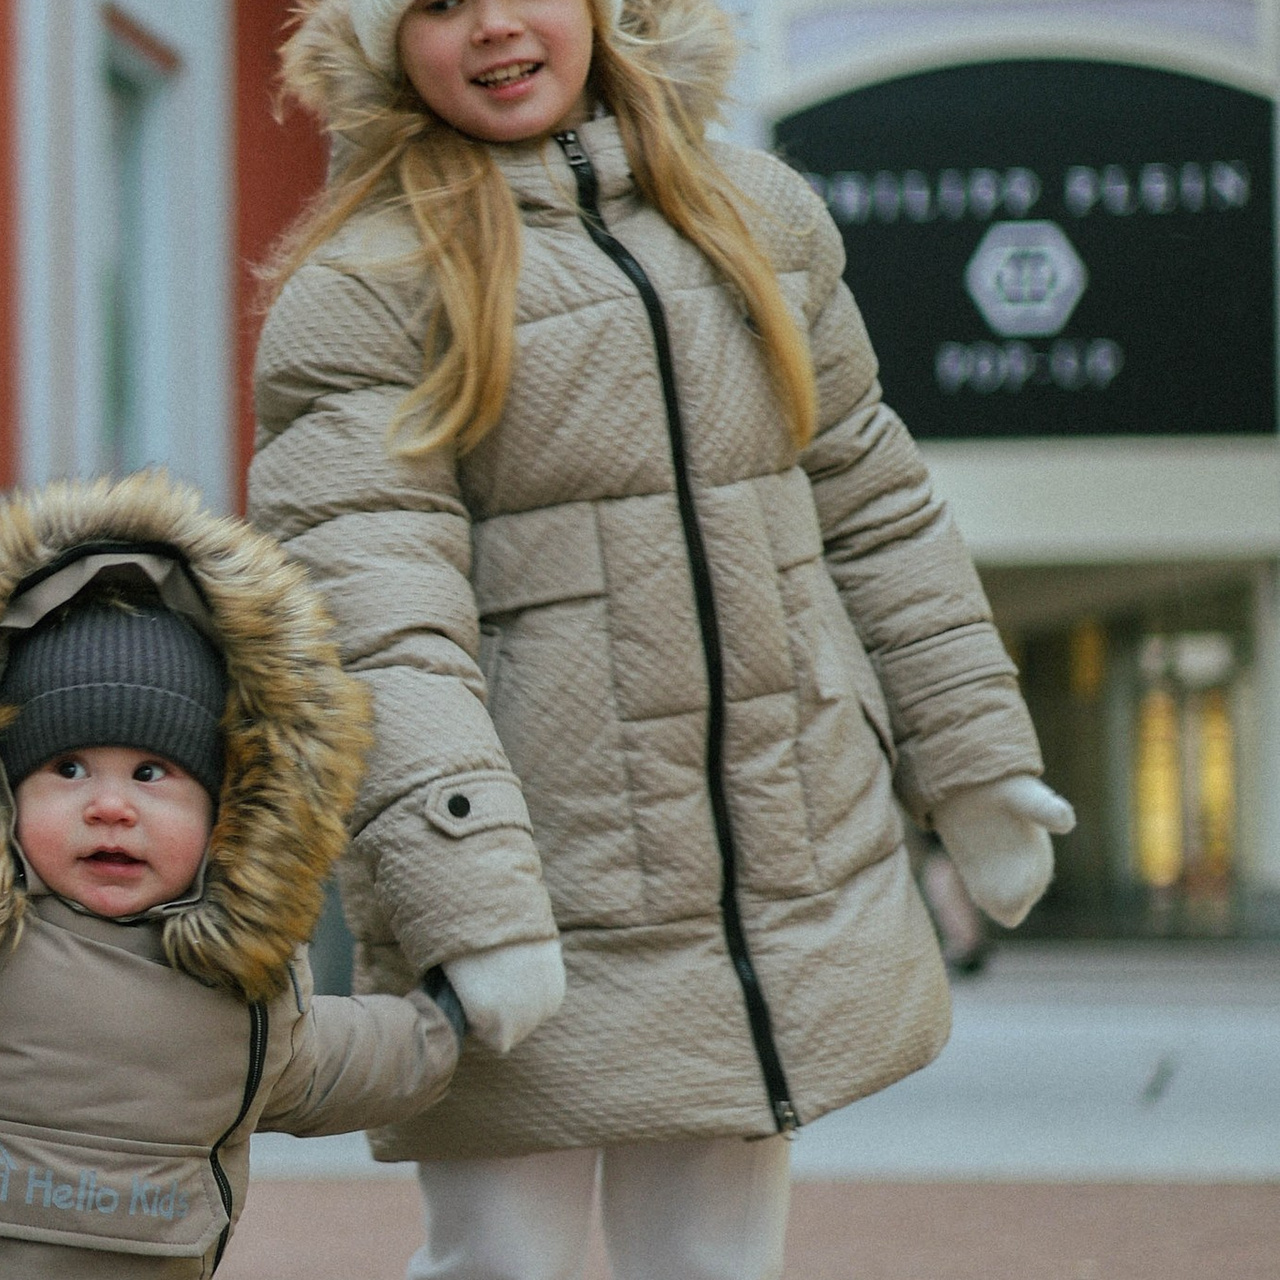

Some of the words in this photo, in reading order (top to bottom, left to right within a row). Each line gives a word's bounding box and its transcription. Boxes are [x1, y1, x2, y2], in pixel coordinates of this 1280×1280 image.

[1064, 160, 1250, 215] PLEIN
[25, 1165, 119, 1215] Hello
[129, 1173, 191, 1220] Kids
